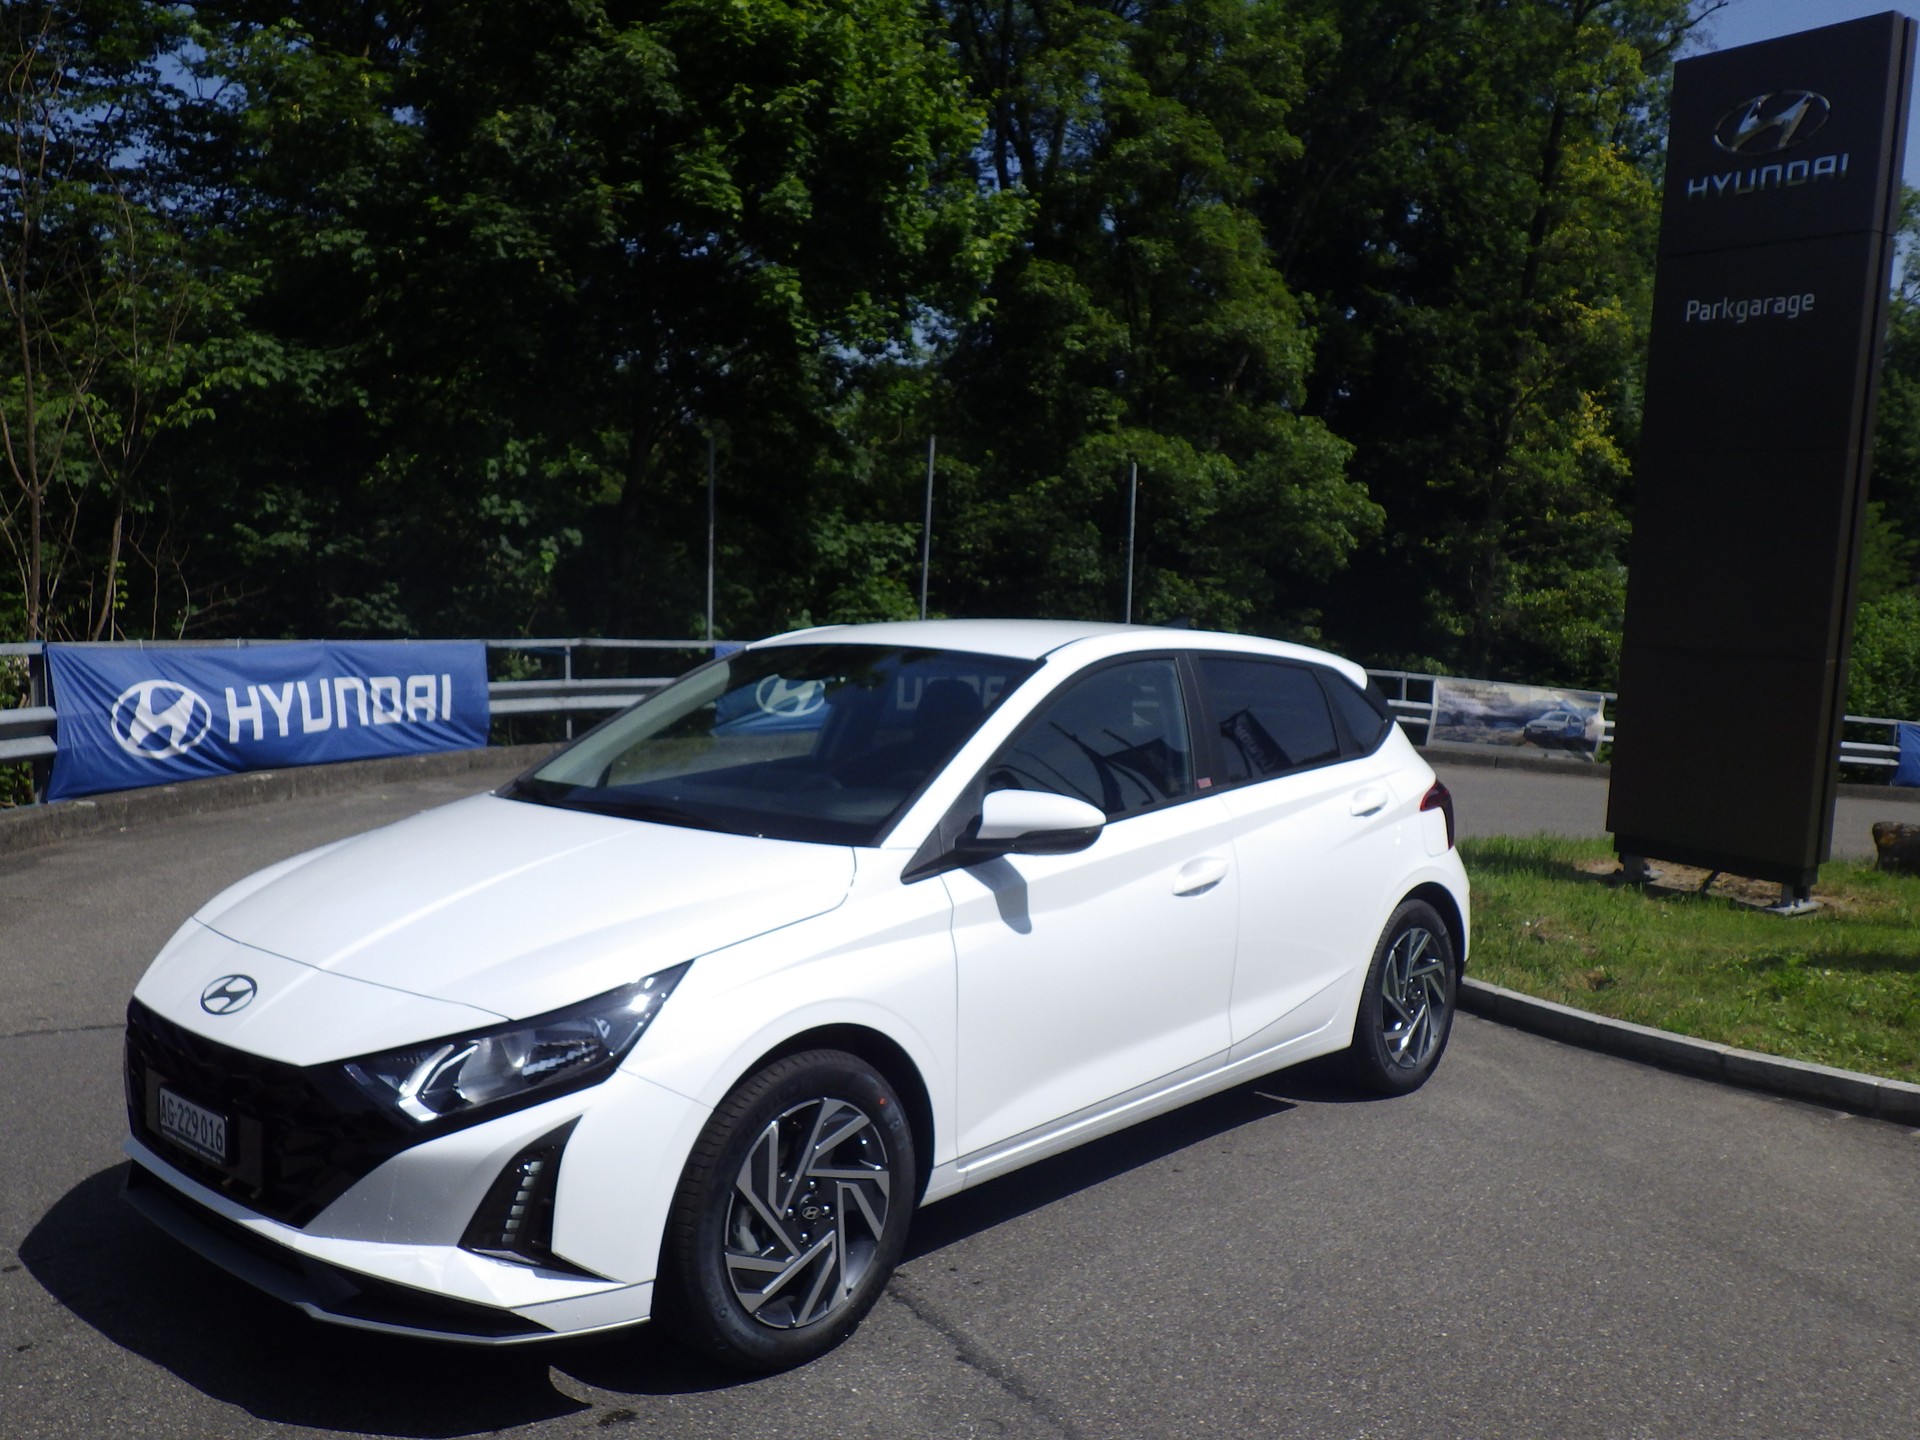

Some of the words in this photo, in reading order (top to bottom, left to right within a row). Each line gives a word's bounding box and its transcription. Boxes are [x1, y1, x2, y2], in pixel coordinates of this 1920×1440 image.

[1687, 152, 1849, 197] HYUNDAI
[1685, 293, 1816, 324] Parkgarage
[225, 674, 452, 744] HYUNDAI
